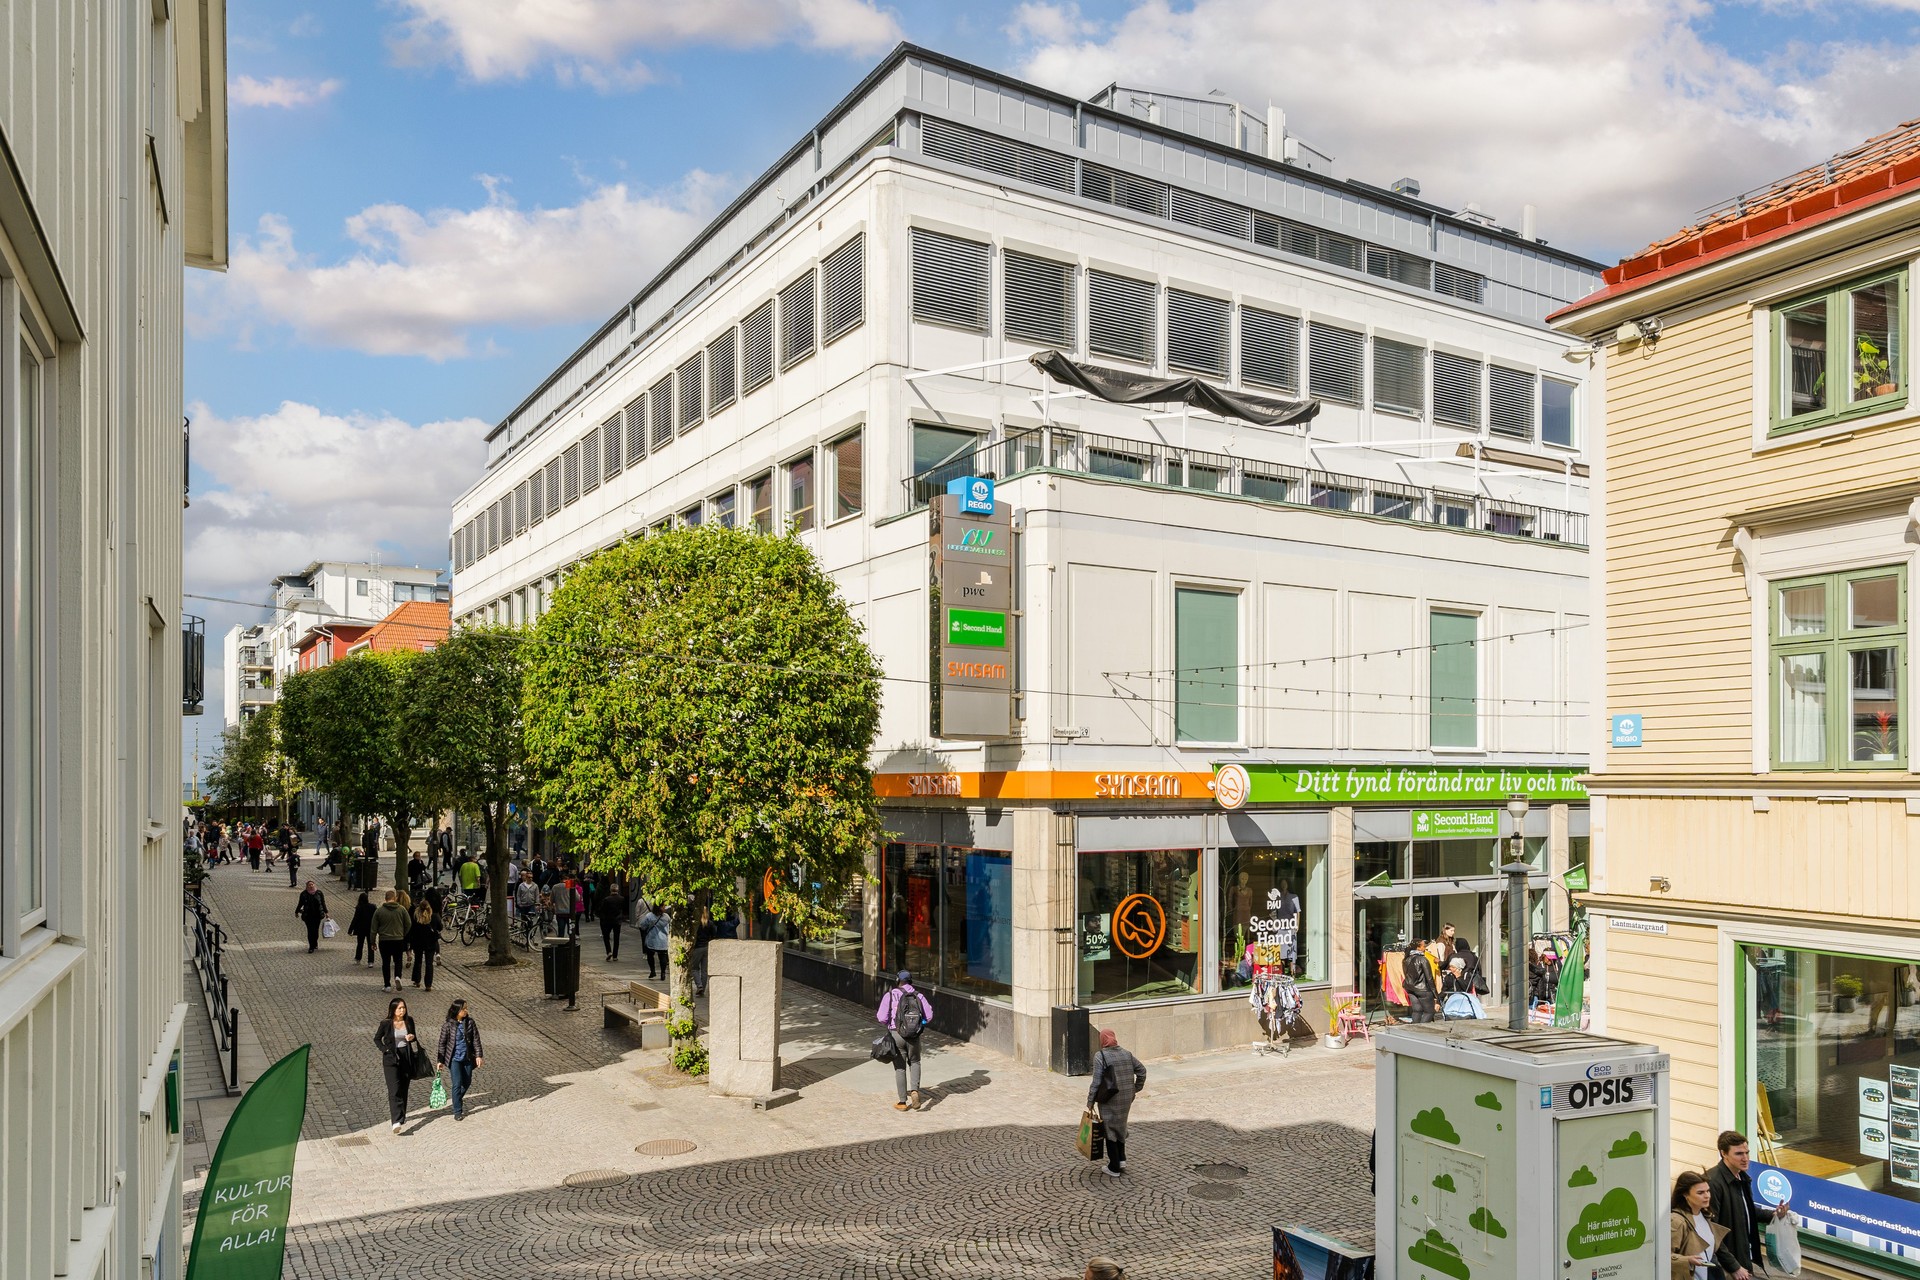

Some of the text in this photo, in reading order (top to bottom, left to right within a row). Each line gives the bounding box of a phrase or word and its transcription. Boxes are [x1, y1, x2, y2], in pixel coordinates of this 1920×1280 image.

[967, 501, 993, 511] REGIO
[963, 585, 985, 597] pwc
[962, 623, 1002, 633] Second Hand
[948, 661, 1006, 680] SYNSAM
[1616, 735, 1638, 743] REGIO
[906, 775, 962, 797] SYNSAM
[1095, 774, 1181, 797] SYNSAM
[1295, 769, 1341, 793] Ditt
[1346, 767, 1392, 799] fynd
[1397, 768, 1495, 793] förändrar
[1500, 768, 1522, 792] liv
[1527, 769, 1556, 792] och
[1434, 812, 1494, 825] Second Hand
[1249, 913, 1299, 932] Second
[1086, 934, 1107, 945] 50%
[1256, 930, 1293, 946] Hand
[1569, 1077, 1634, 1109] OPSIS
[215, 1175, 292, 1204] KULTUR
[1763, 1189, 1786, 1200] REGIO
[231, 1203, 269, 1226] FÖR
[1587, 1216, 1630, 1231] Här mäter vi
[219, 1227, 277, 1252] ALLA!
[1580, 1227, 1637, 1245] luftkvalitén i city
